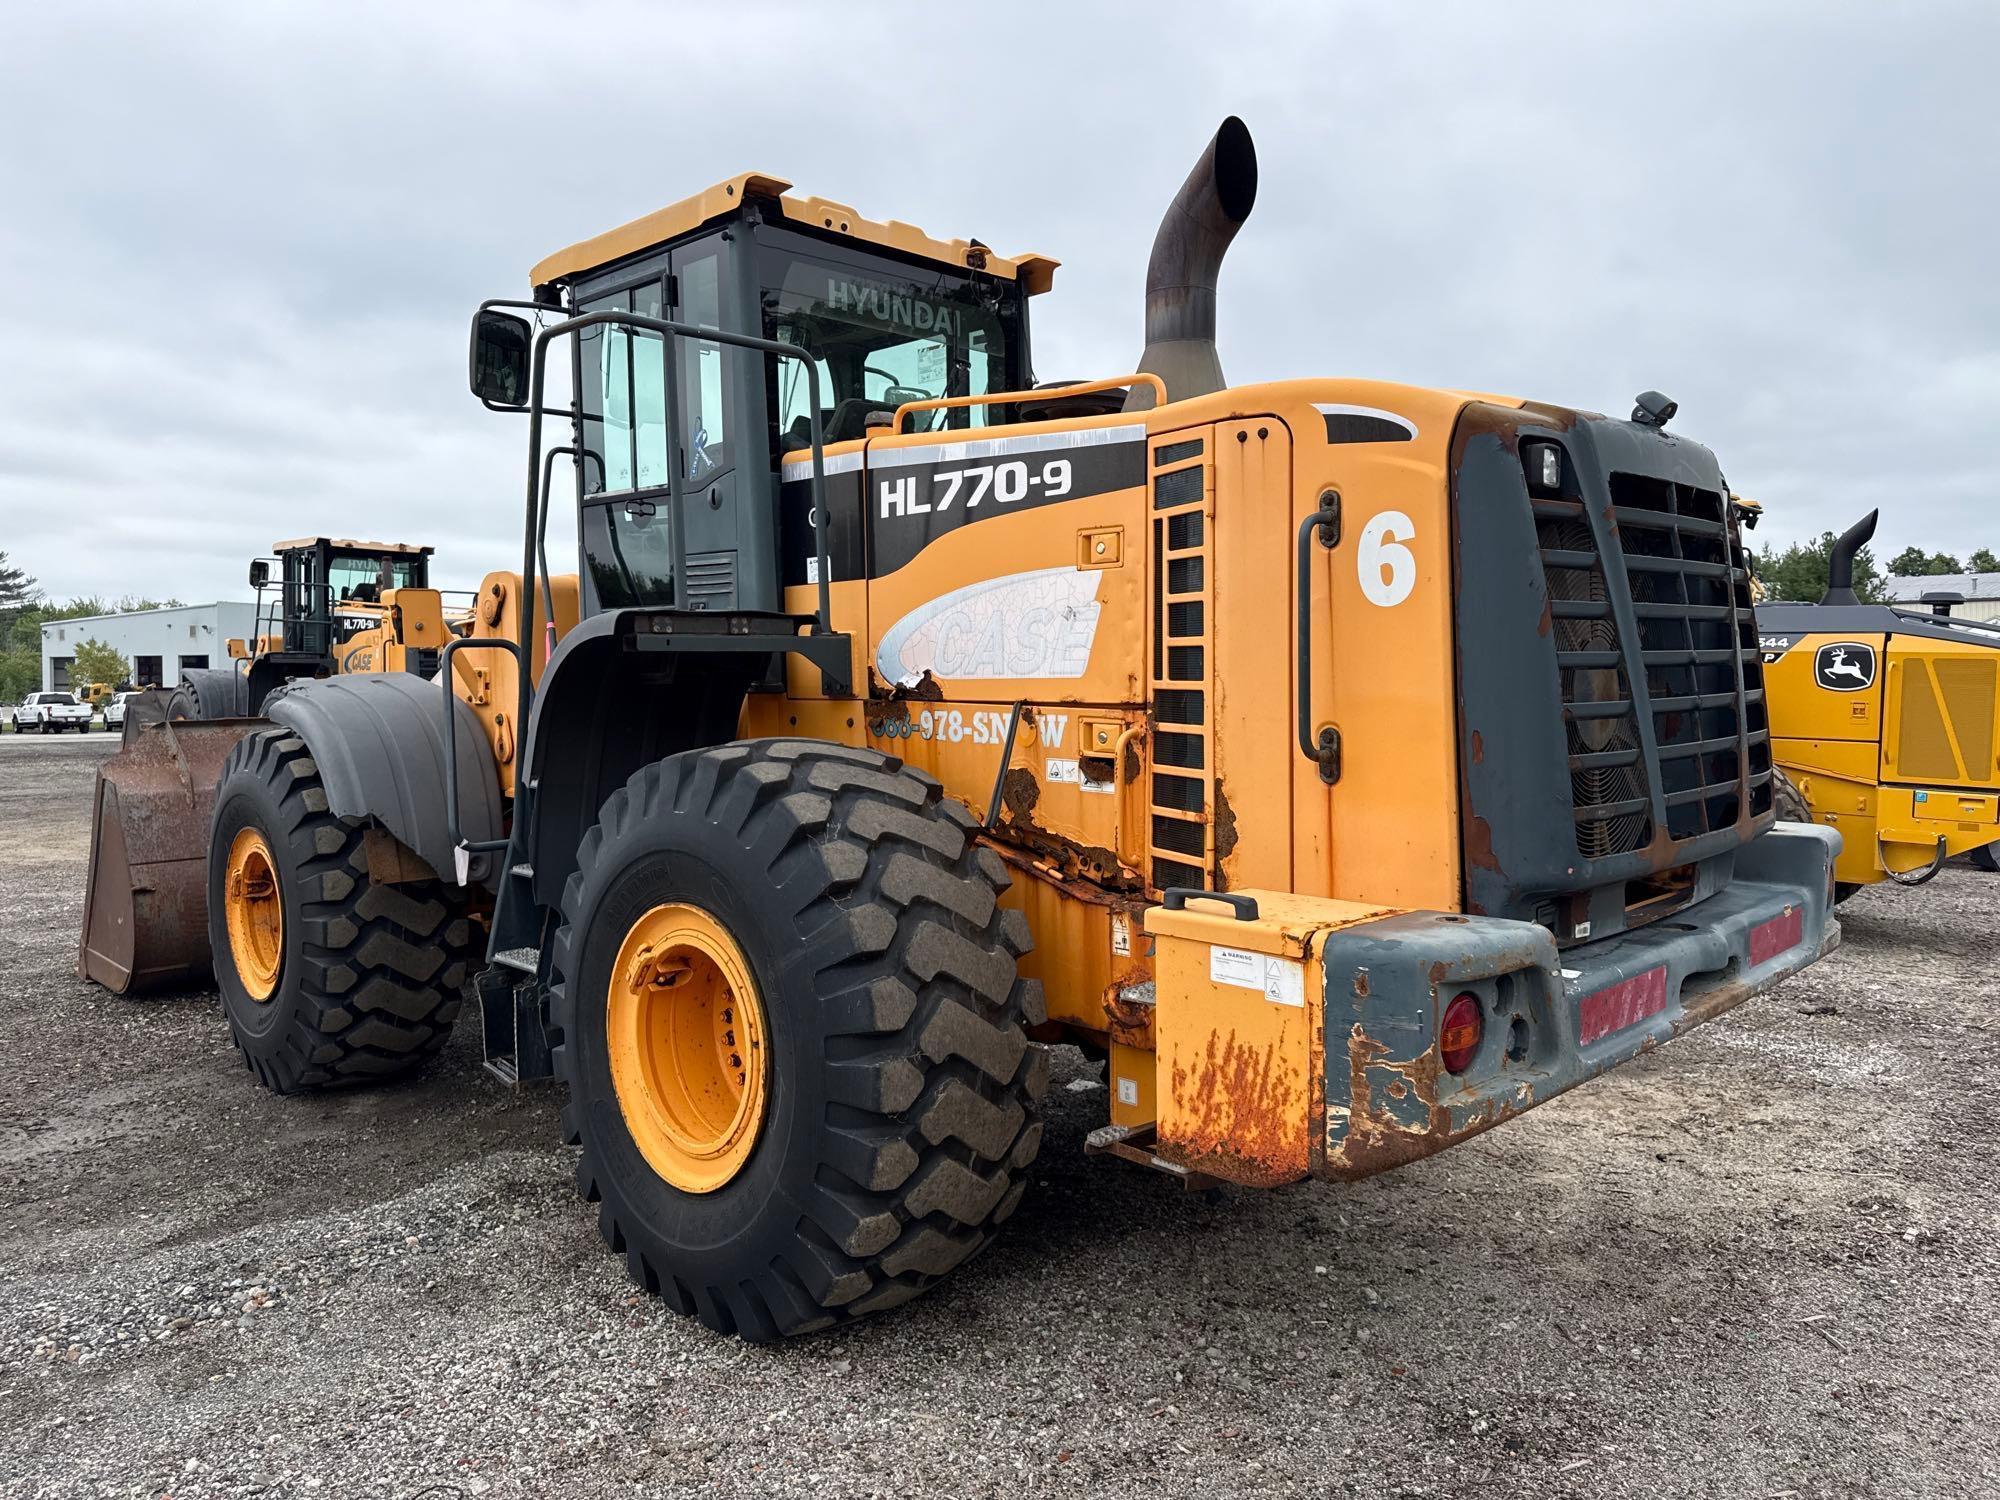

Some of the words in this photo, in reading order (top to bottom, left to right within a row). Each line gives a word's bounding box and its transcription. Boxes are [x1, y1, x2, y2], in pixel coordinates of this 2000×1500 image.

[827, 278, 961, 337] HYUNDAI
[880, 459, 1072, 518] HL770-9
[1357, 510, 1417, 607] 6
[933, 605, 1100, 675] CASE
[1227, 951, 1253, 961] WARNING
